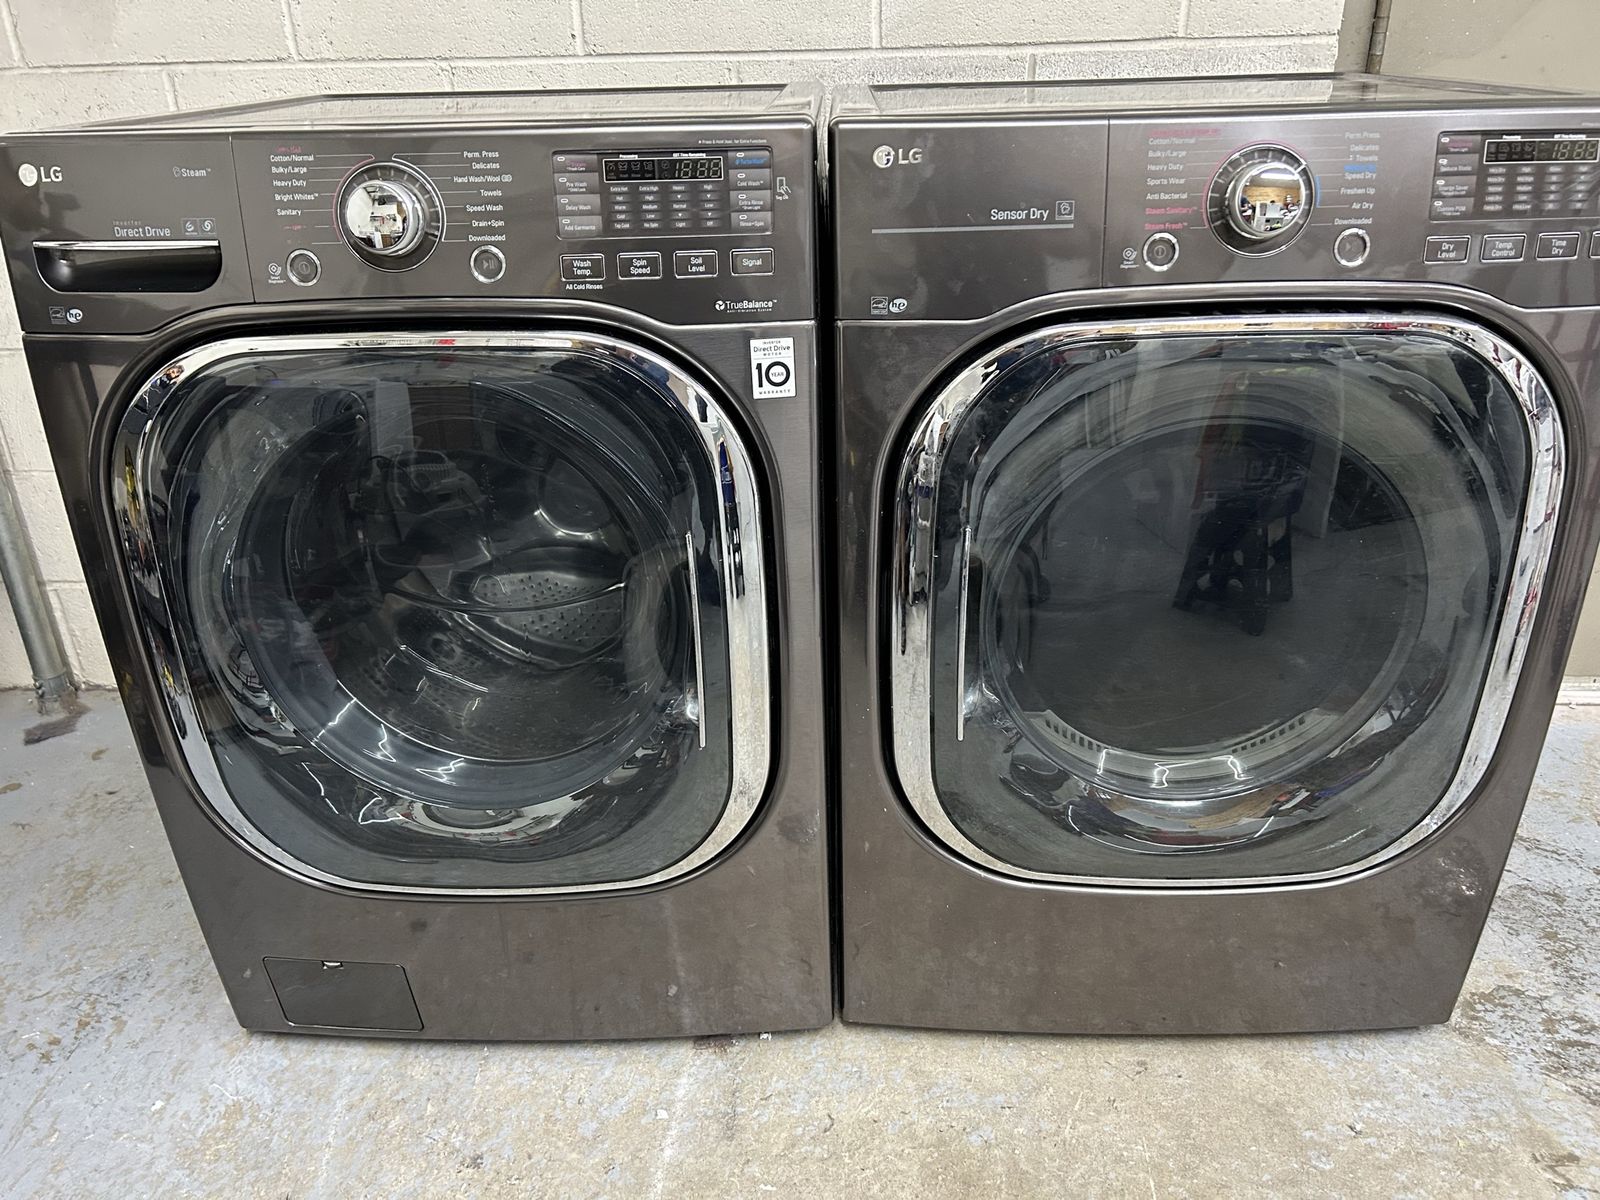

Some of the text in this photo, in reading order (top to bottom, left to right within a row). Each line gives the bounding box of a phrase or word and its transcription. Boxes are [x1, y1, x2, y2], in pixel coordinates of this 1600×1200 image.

[1148, 137, 1196, 145] Cotton/Normal
[270, 154, 315, 162] Cotton/Normal
[898, 148, 923, 164] LG
[1148, 150, 1187, 158] Bulky/Large
[472, 162, 500, 170] Delicates
[1147, 163, 1183, 172] Heavy Duty
[40, 166, 63, 182] LG
[271, 166, 308, 175] Bulky/Large
[469, 175, 501, 183] Wash/Wool
[1366, 172, 1377, 180] Dry
[273, 180, 292, 188] Heavy
[1147, 178, 1168, 186] Sports
[480, 189, 503, 197] Towels
[1341, 187, 1376, 195] Freshen Up
[275, 194, 294, 202] Bright
[1160, 192, 1188, 200] Bacterial
[466, 204, 504, 214] Speed Wash
[1352, 202, 1374, 210] Air Dry
[277, 209, 302, 217] Sanitary
[991, 208, 1049, 221] Sensor Dry
[472, 220, 505, 229] Drain+Spin
[1334, 218, 1373, 226] Downloaded
[115, 226, 171, 238] Direct Drive
[469, 234, 506, 243] Downloaded
[1496, 242, 1514, 250] Temp.
[1552, 239, 1567, 247] Time
[1442, 243, 1455, 252] Dry
[1552, 247, 1564, 256] Dry
[1438, 251, 1456, 259] Level
[1492, 249, 1516, 257] Control
[573, 260, 592, 268] Wash
[633, 259, 648, 267] Spin
[690, 257, 703, 265] Soil
[742, 257, 763, 267] Signal
[573, 268, 593, 276] Temp.
[630, 266, 651, 275] Speed
[688, 265, 706, 273] Level
[756, 361, 791, 388] 10
